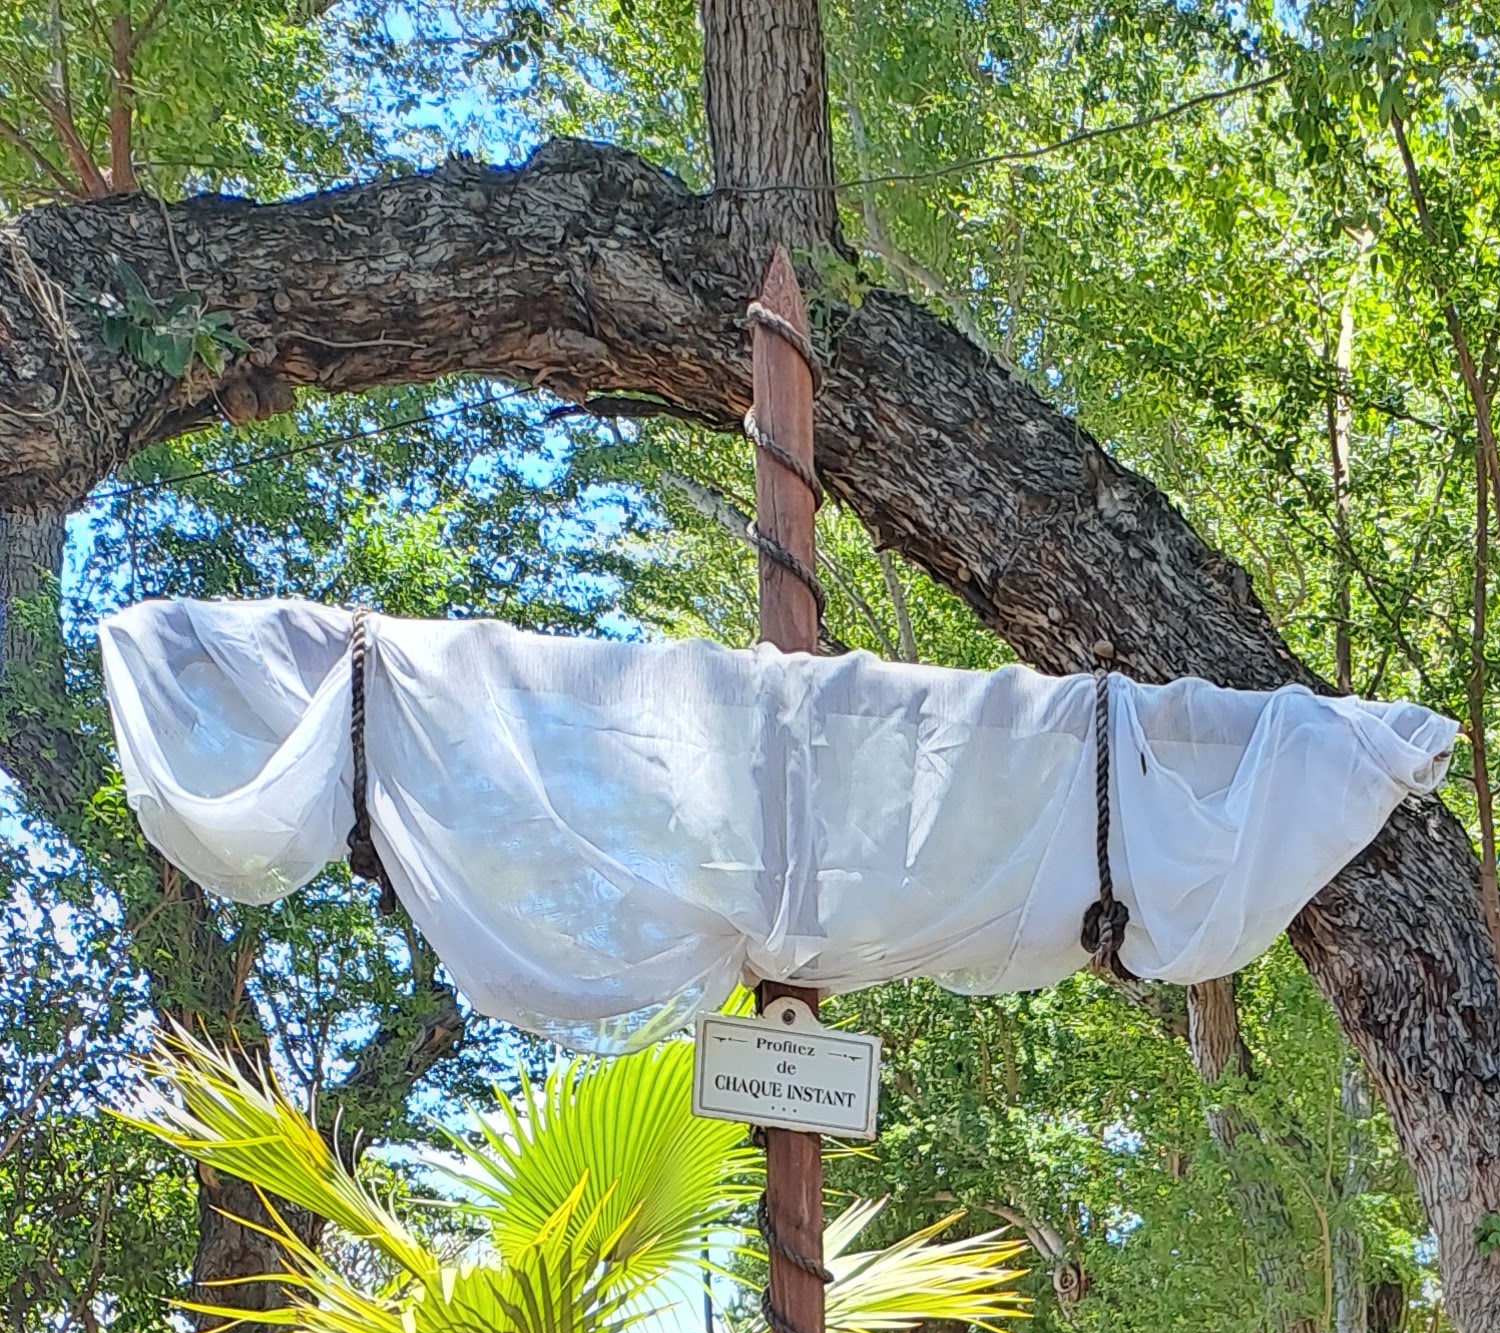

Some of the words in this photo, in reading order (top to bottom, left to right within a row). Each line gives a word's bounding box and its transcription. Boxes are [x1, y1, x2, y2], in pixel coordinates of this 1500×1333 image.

[756, 1037, 816, 1057] Profitez
[777, 1060, 796, 1075] de
[715, 1074, 783, 1098] CHAQUE
[787, 1084, 856, 1108] INSTANT
